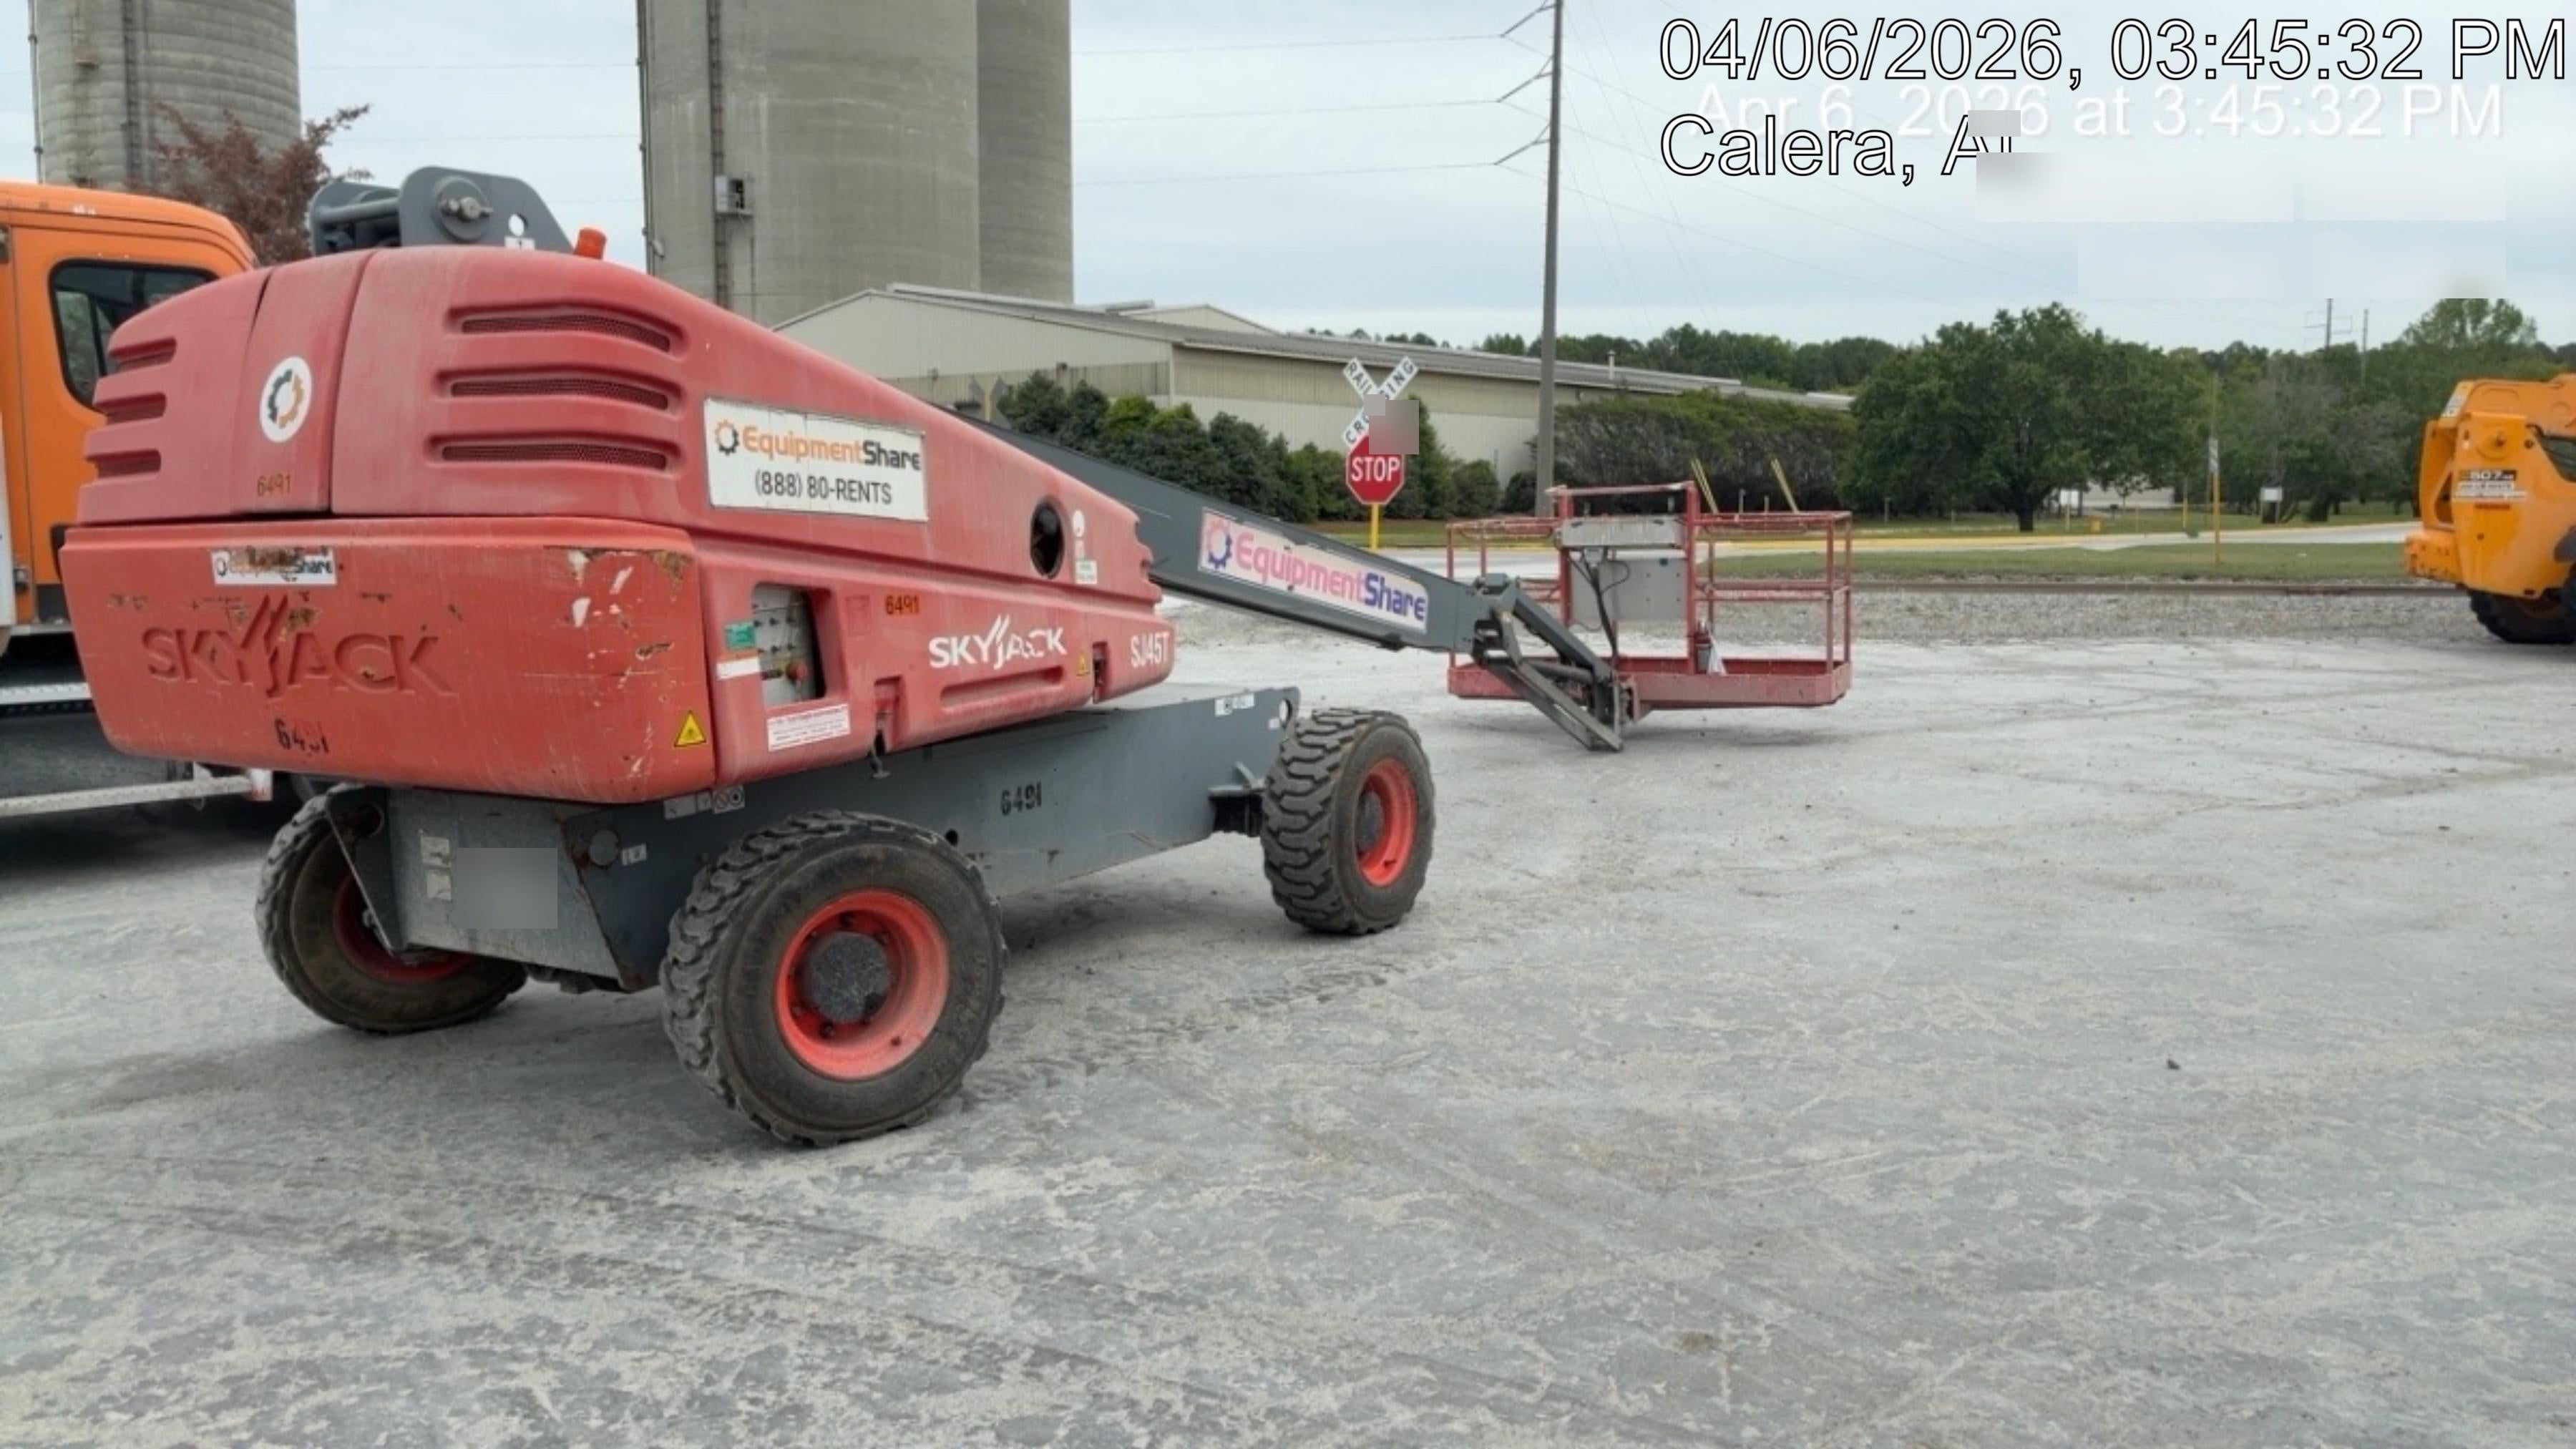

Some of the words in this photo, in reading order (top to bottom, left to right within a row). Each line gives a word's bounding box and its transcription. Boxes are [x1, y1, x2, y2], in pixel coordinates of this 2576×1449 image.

[1345, 360, 1414, 444] CRING
[742, 425, 921, 471] EquipmentShare
[258, 473, 291, 497] 6491
[755, 469, 803, 498] (888)
[807, 476, 892, 504] 80-RENTS
[1351, 456, 1400, 482] STOP
[1235, 531, 1426, 620] EquipmentShare
[885, 594, 919, 615] 6491
[142, 594, 459, 699] SKYJACK
[928, 613, 1068, 670] SKYJACK
[1131, 632, 1169, 668] SJ45T
[275, 718, 330, 754] 641
[1001, 782, 1042, 816] 6491
